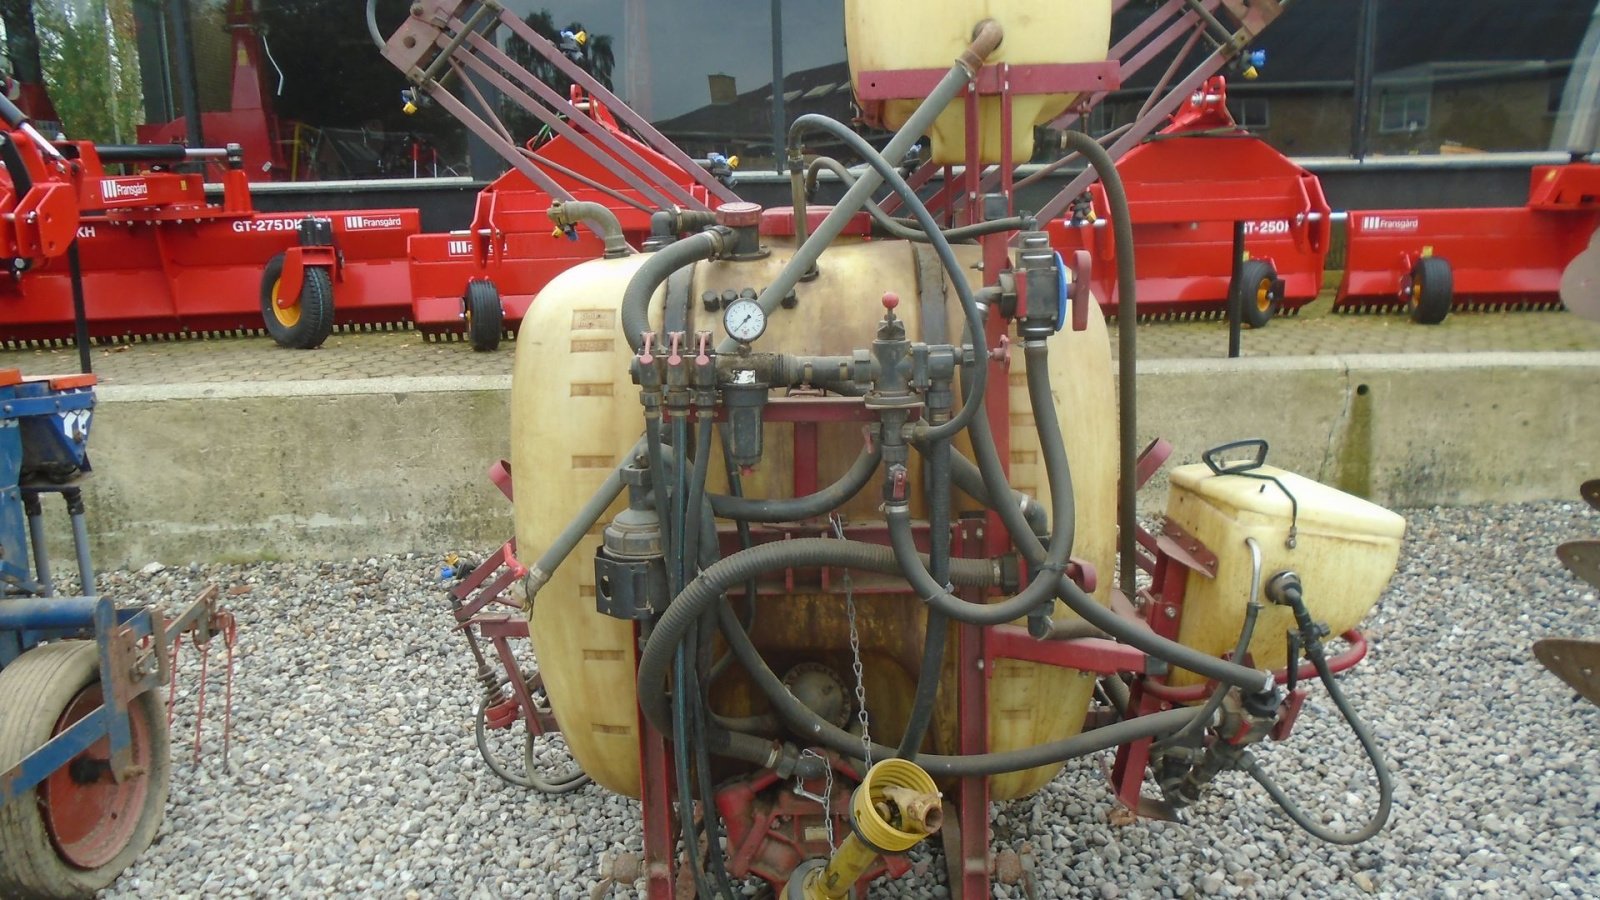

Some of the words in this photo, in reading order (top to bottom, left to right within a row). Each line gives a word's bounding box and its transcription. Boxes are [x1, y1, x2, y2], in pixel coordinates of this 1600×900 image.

[116, 182, 148, 197] Fransgård
[363, 217, 402, 228] Fransgård
[1380, 219, 1419, 230] Fransgård
